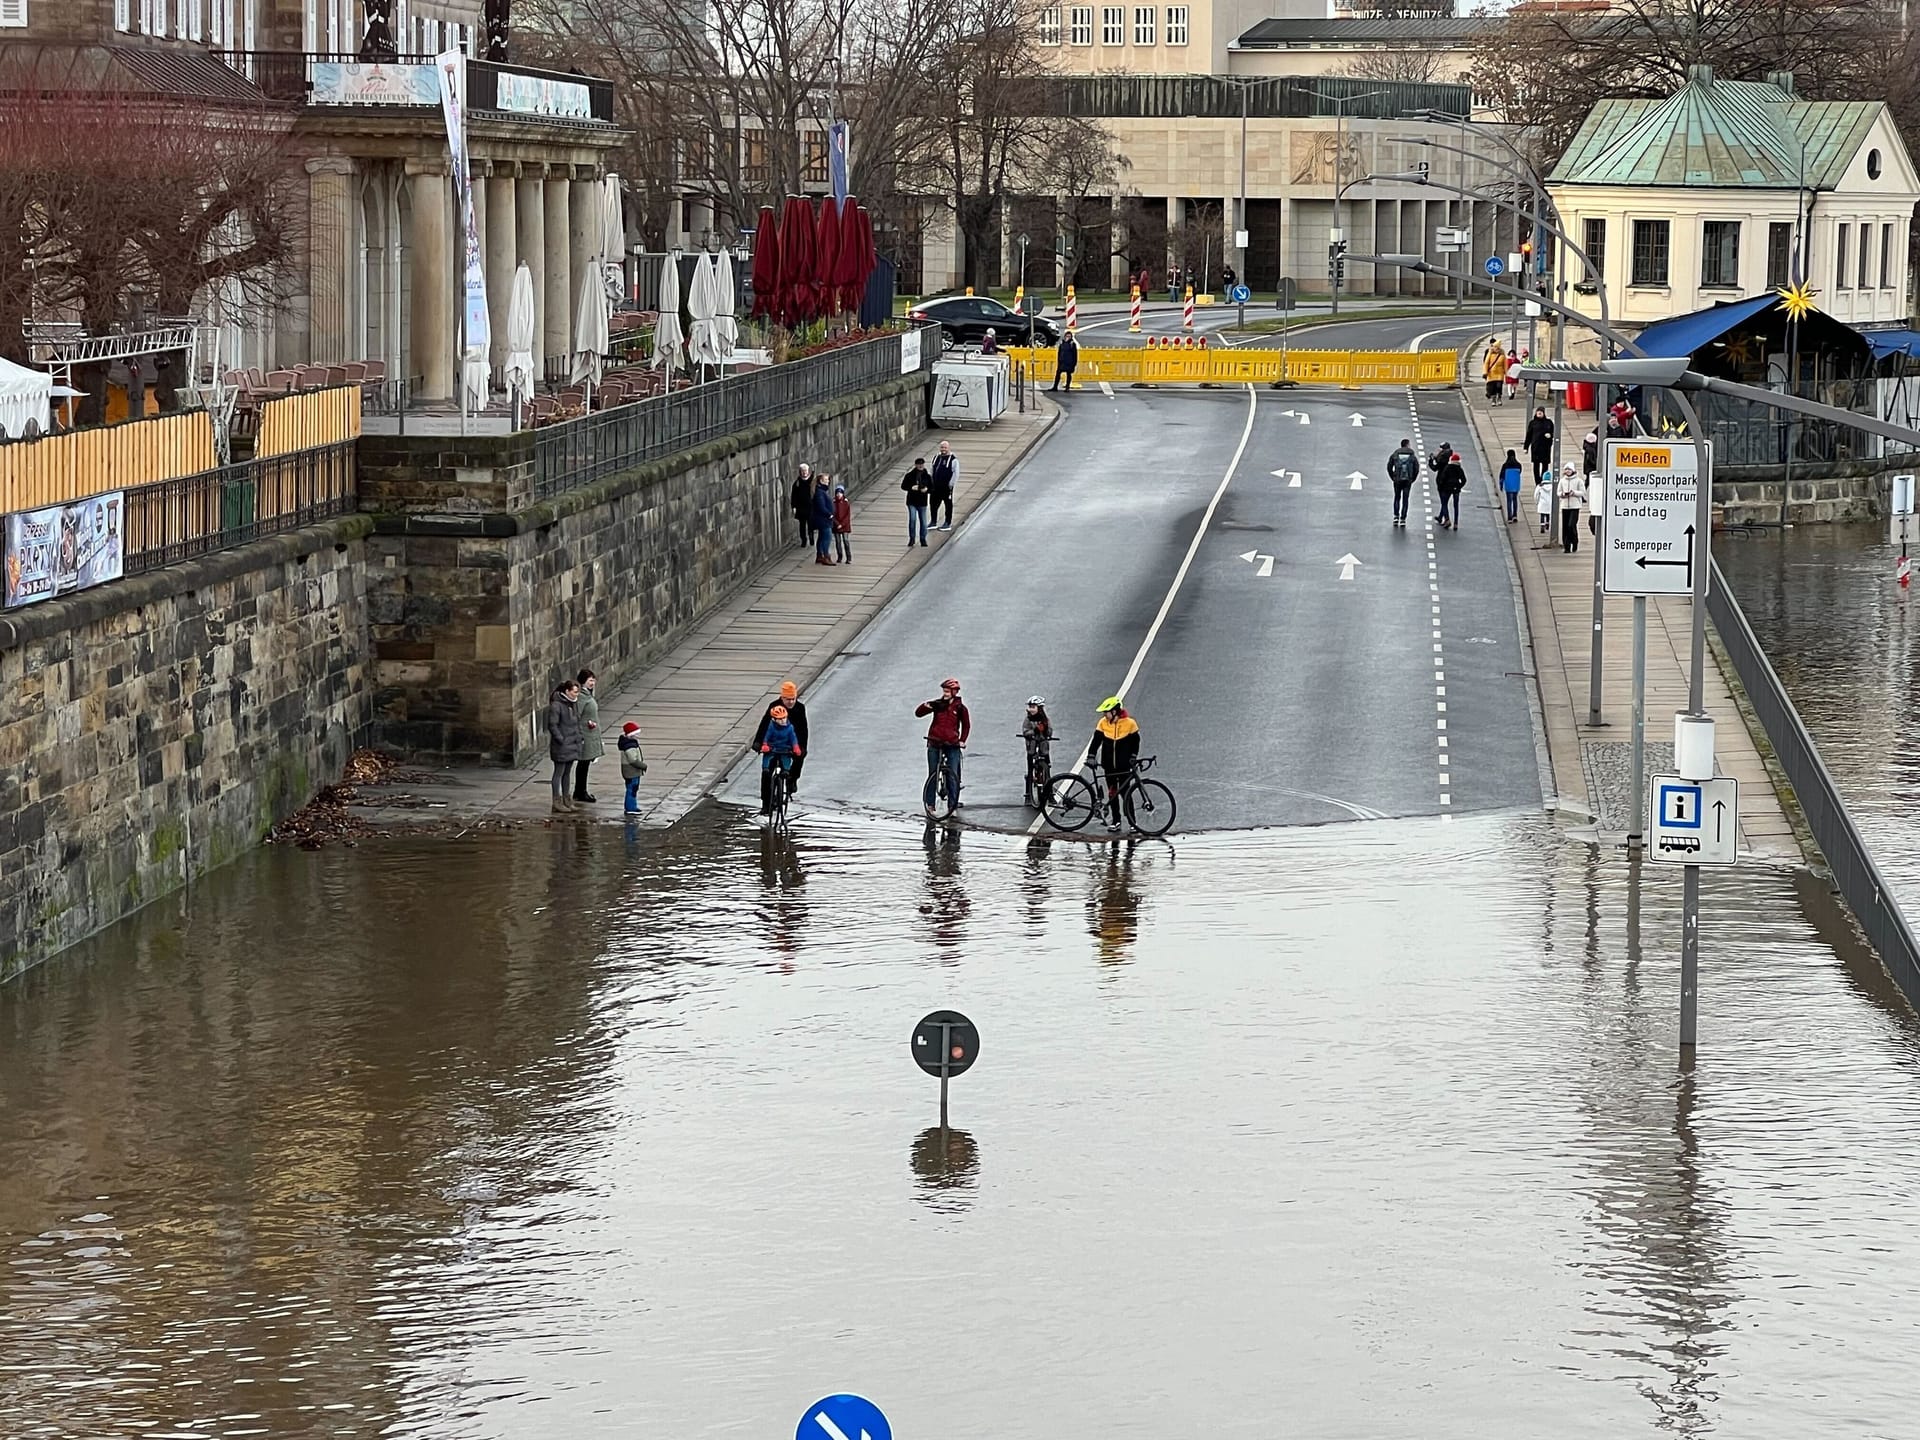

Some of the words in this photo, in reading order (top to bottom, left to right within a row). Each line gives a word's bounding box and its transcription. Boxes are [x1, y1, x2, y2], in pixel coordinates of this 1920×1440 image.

[1620, 451, 1667, 464] Meißen
[1615, 473, 1697, 488] Messe/Sportpark
[1614, 505, 1667, 520] Landtag
[1614, 538, 1673, 553] Semperoper
[19, 542, 52, 577] PARTY
